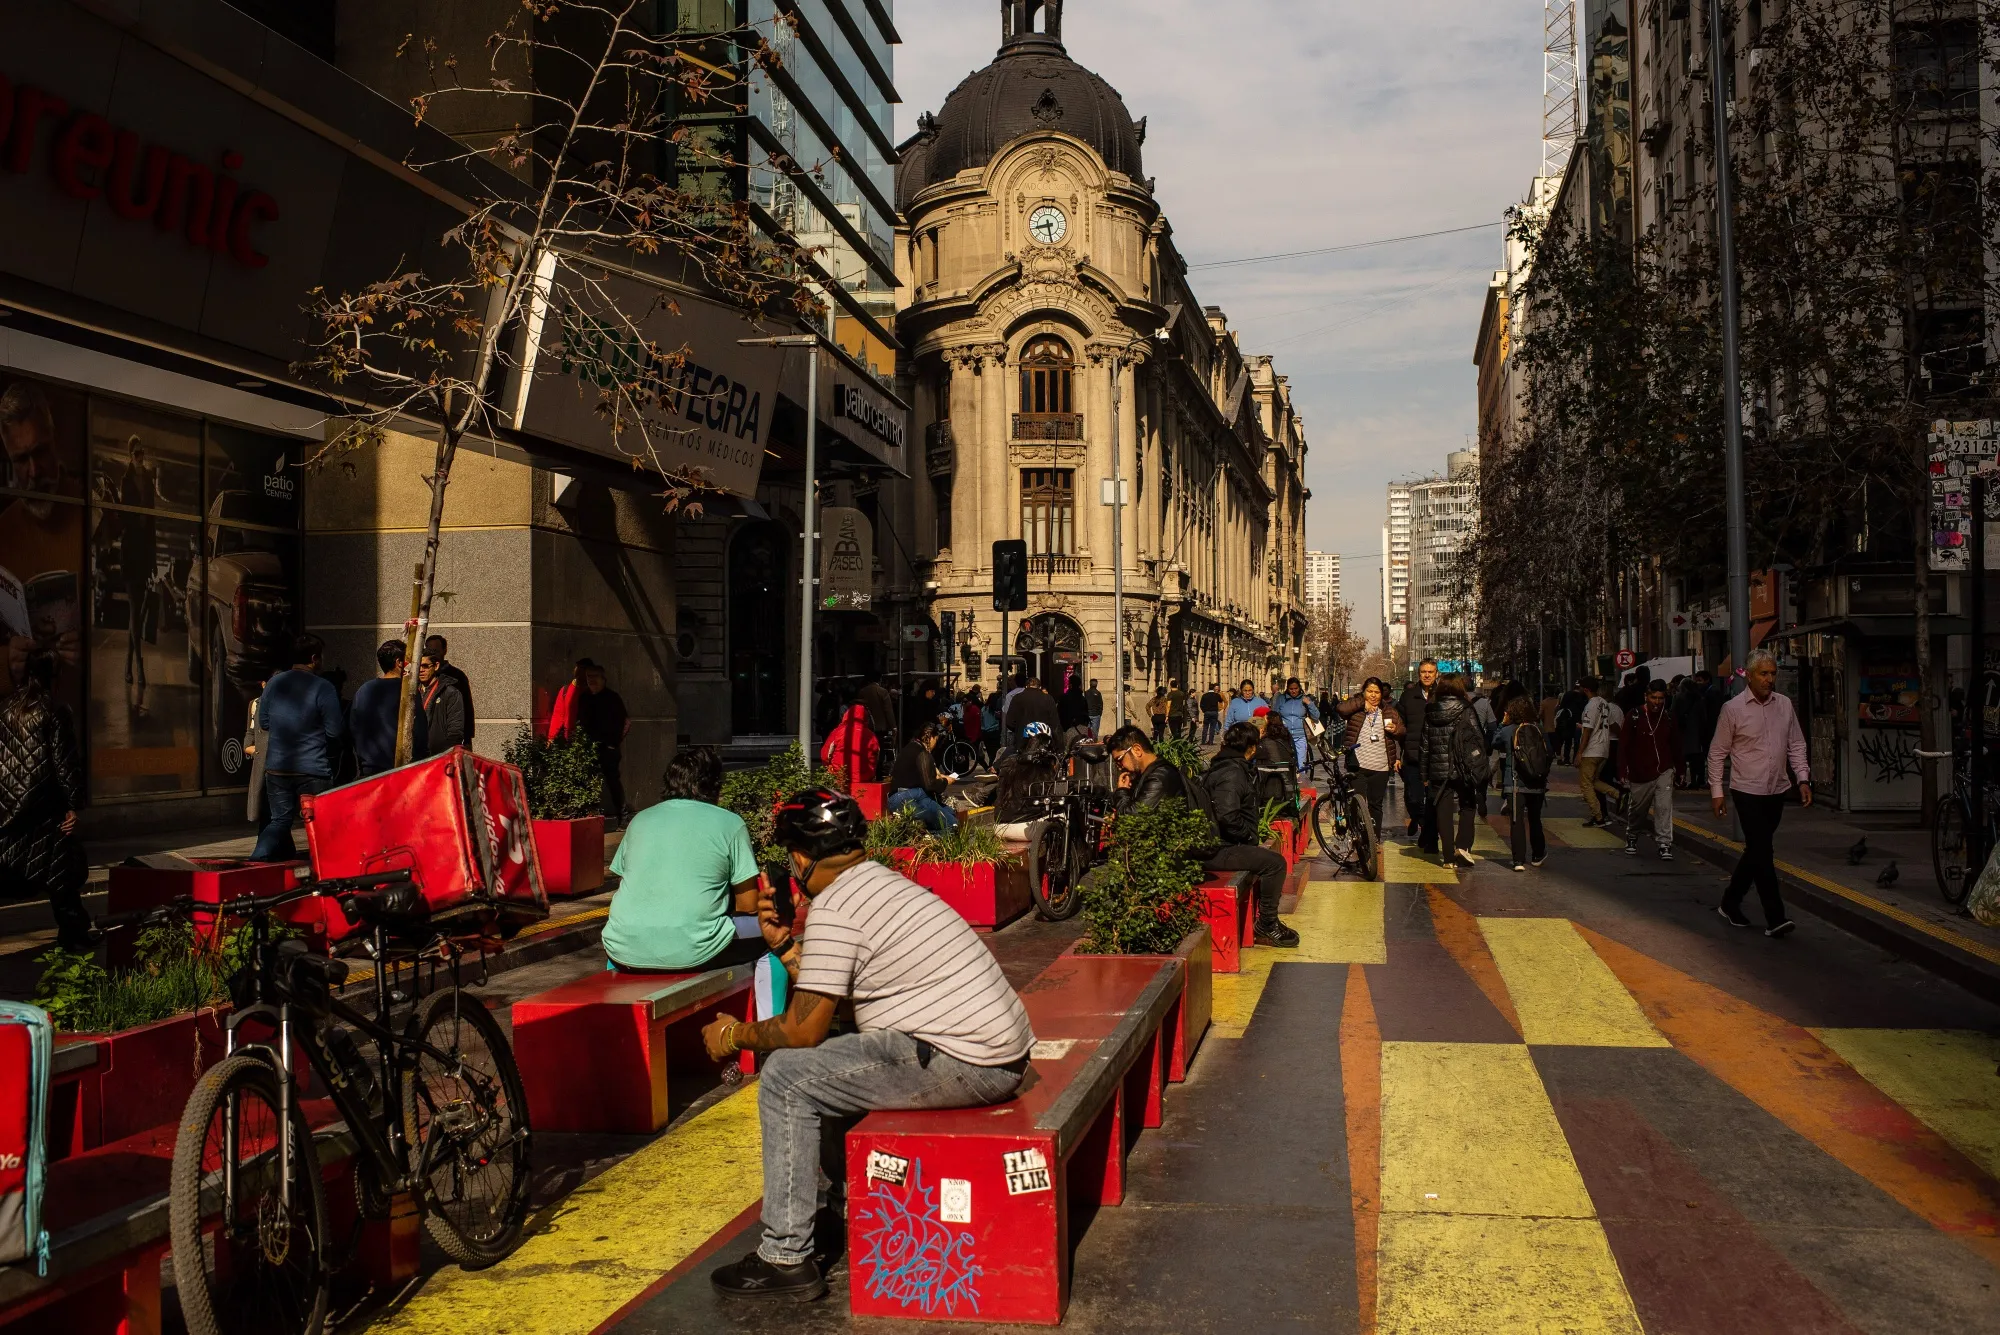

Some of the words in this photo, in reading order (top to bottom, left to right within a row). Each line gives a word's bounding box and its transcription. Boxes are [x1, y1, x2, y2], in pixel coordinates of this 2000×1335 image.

[0, 70, 279, 268] reunic
[987, 292, 1026, 323] BOLSA
[1044, 284, 1107, 323] COMERCIO
[871, 406, 904, 447] CENTRO
[647, 418, 702, 452] CENTROS
[707, 438, 755, 469] MÉDICOS
[263, 474, 294, 491] patio
[265, 488, 293, 501] CENTRO
[829, 556, 863, 571] PASEO
[871, 1151, 908, 1174] POST
[1009, 1170, 1049, 1193] FLIK
